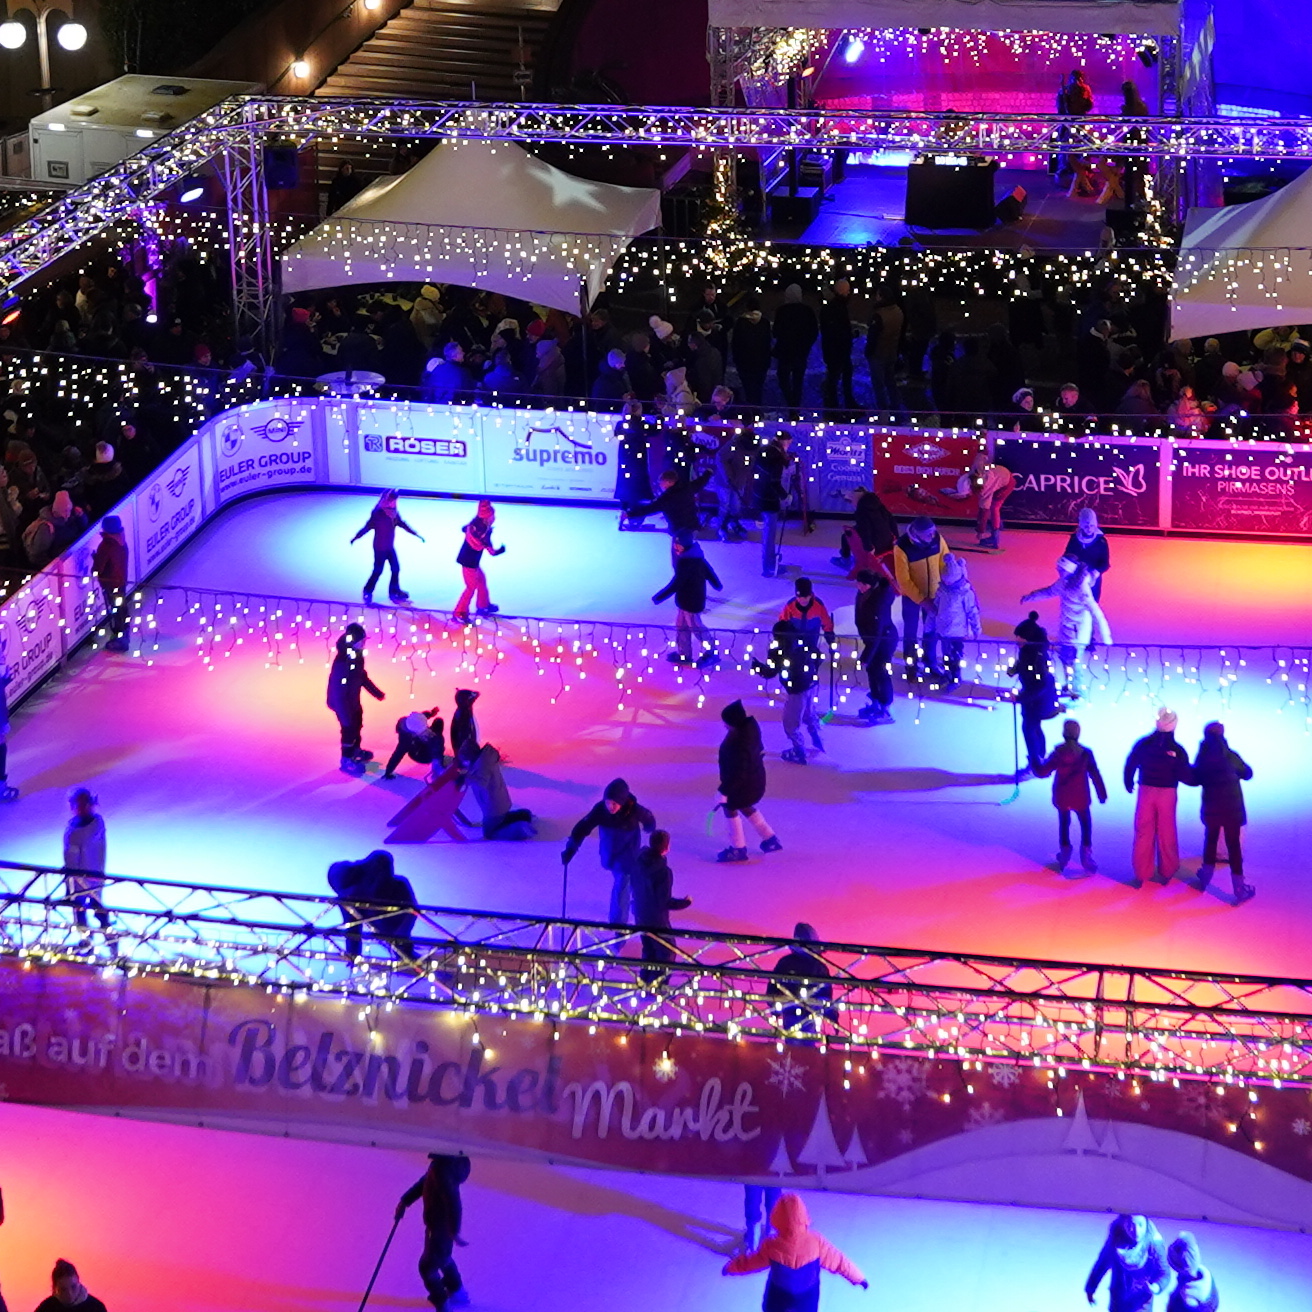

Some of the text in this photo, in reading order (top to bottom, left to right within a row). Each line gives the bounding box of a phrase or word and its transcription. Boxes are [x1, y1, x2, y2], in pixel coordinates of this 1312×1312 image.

[219, 451, 312, 483] EULER GROUP
[512, 447, 608, 467] supremo
[220, 465, 313, 493] www.euler-group.de
[1011, 472, 1114, 496] CAPRICE
[1183, 464, 1211, 478] IHR
[1214, 464, 1261, 480] SHOE
[1217, 481, 1295, 495] PIRMASENS
[48, 1033, 118, 1069] auf
[122, 1038, 214, 1079] dem
[228, 1019, 563, 1117] Belznickel
[564, 1076, 762, 1141] Markt
